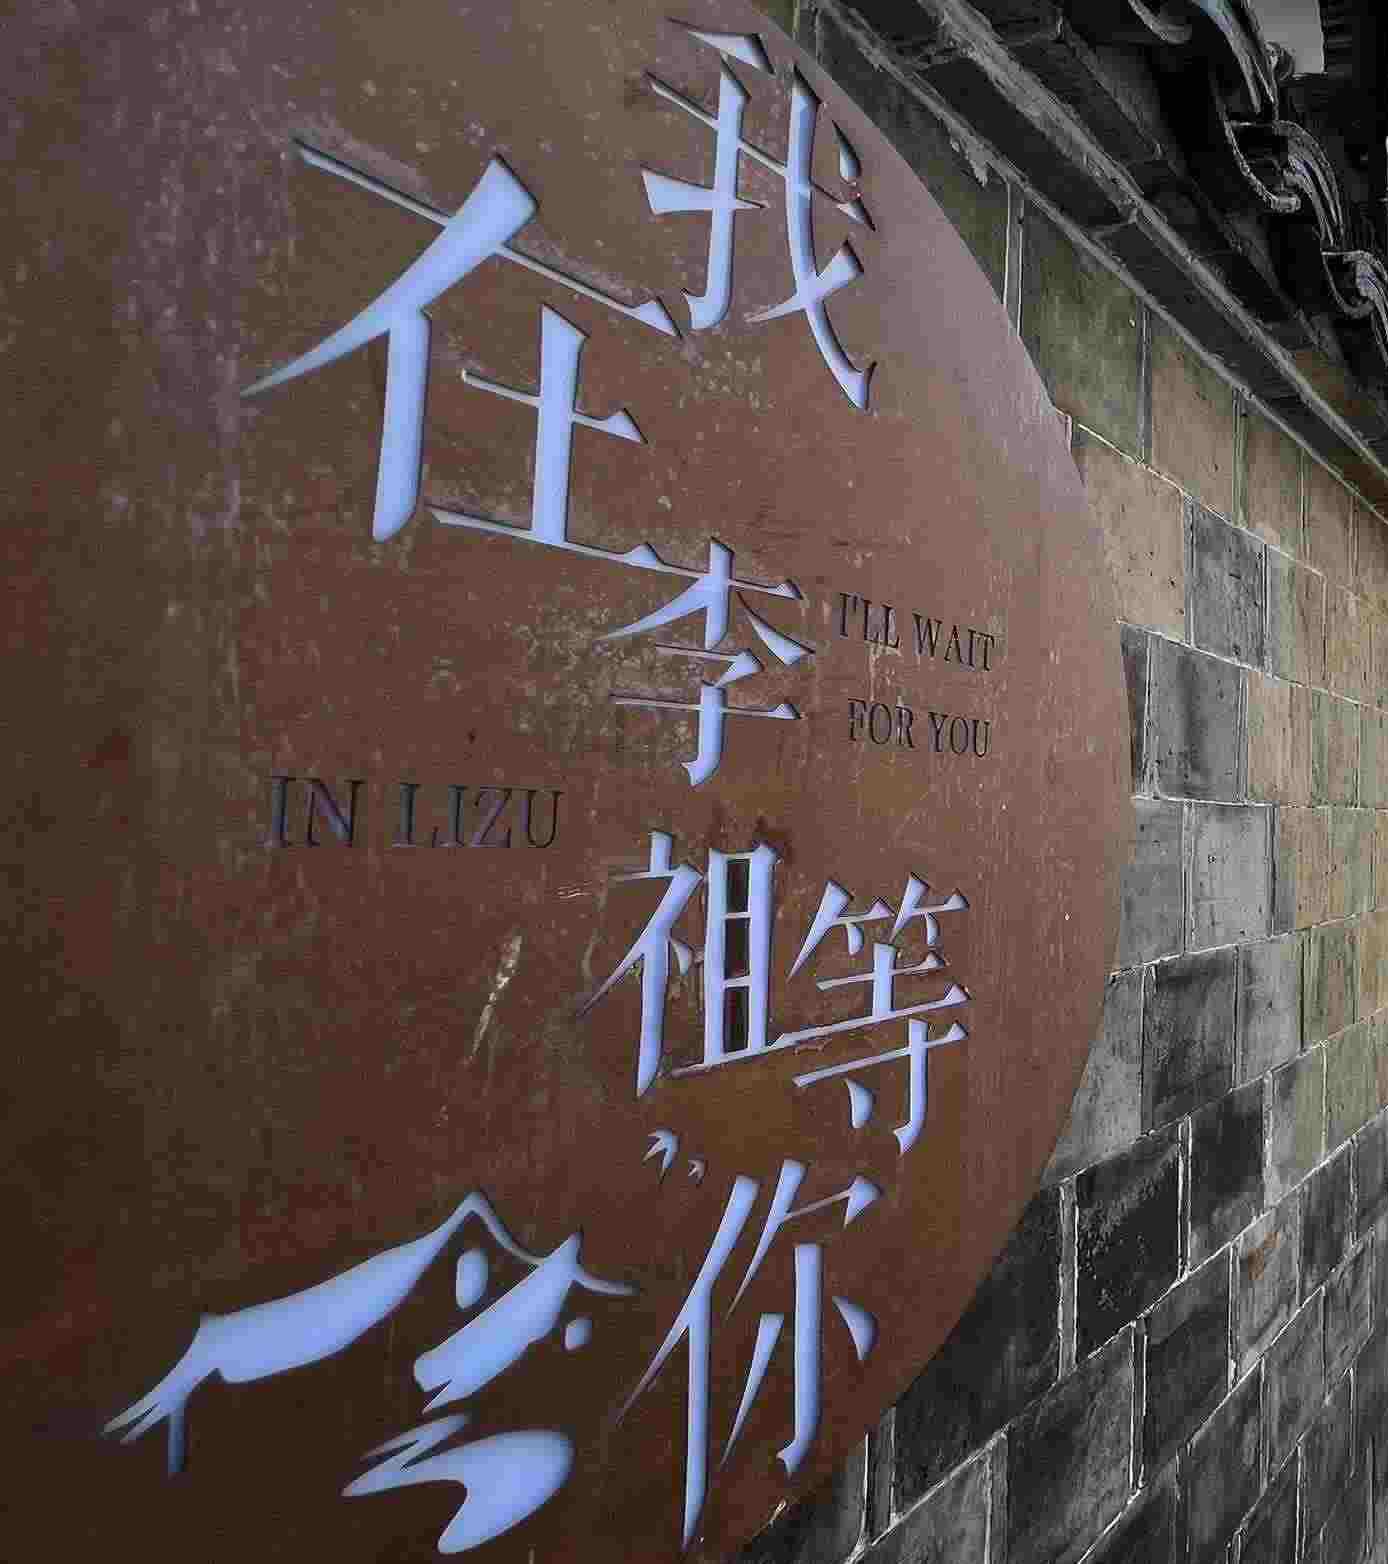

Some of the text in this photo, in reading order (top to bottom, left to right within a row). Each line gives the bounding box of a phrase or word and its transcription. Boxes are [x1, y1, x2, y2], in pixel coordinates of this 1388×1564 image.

[839, 591, 996, 672] I'LL WAIT
[847, 697, 992, 758] FOR YOU
[264, 775, 564, 849] IN LIZU
